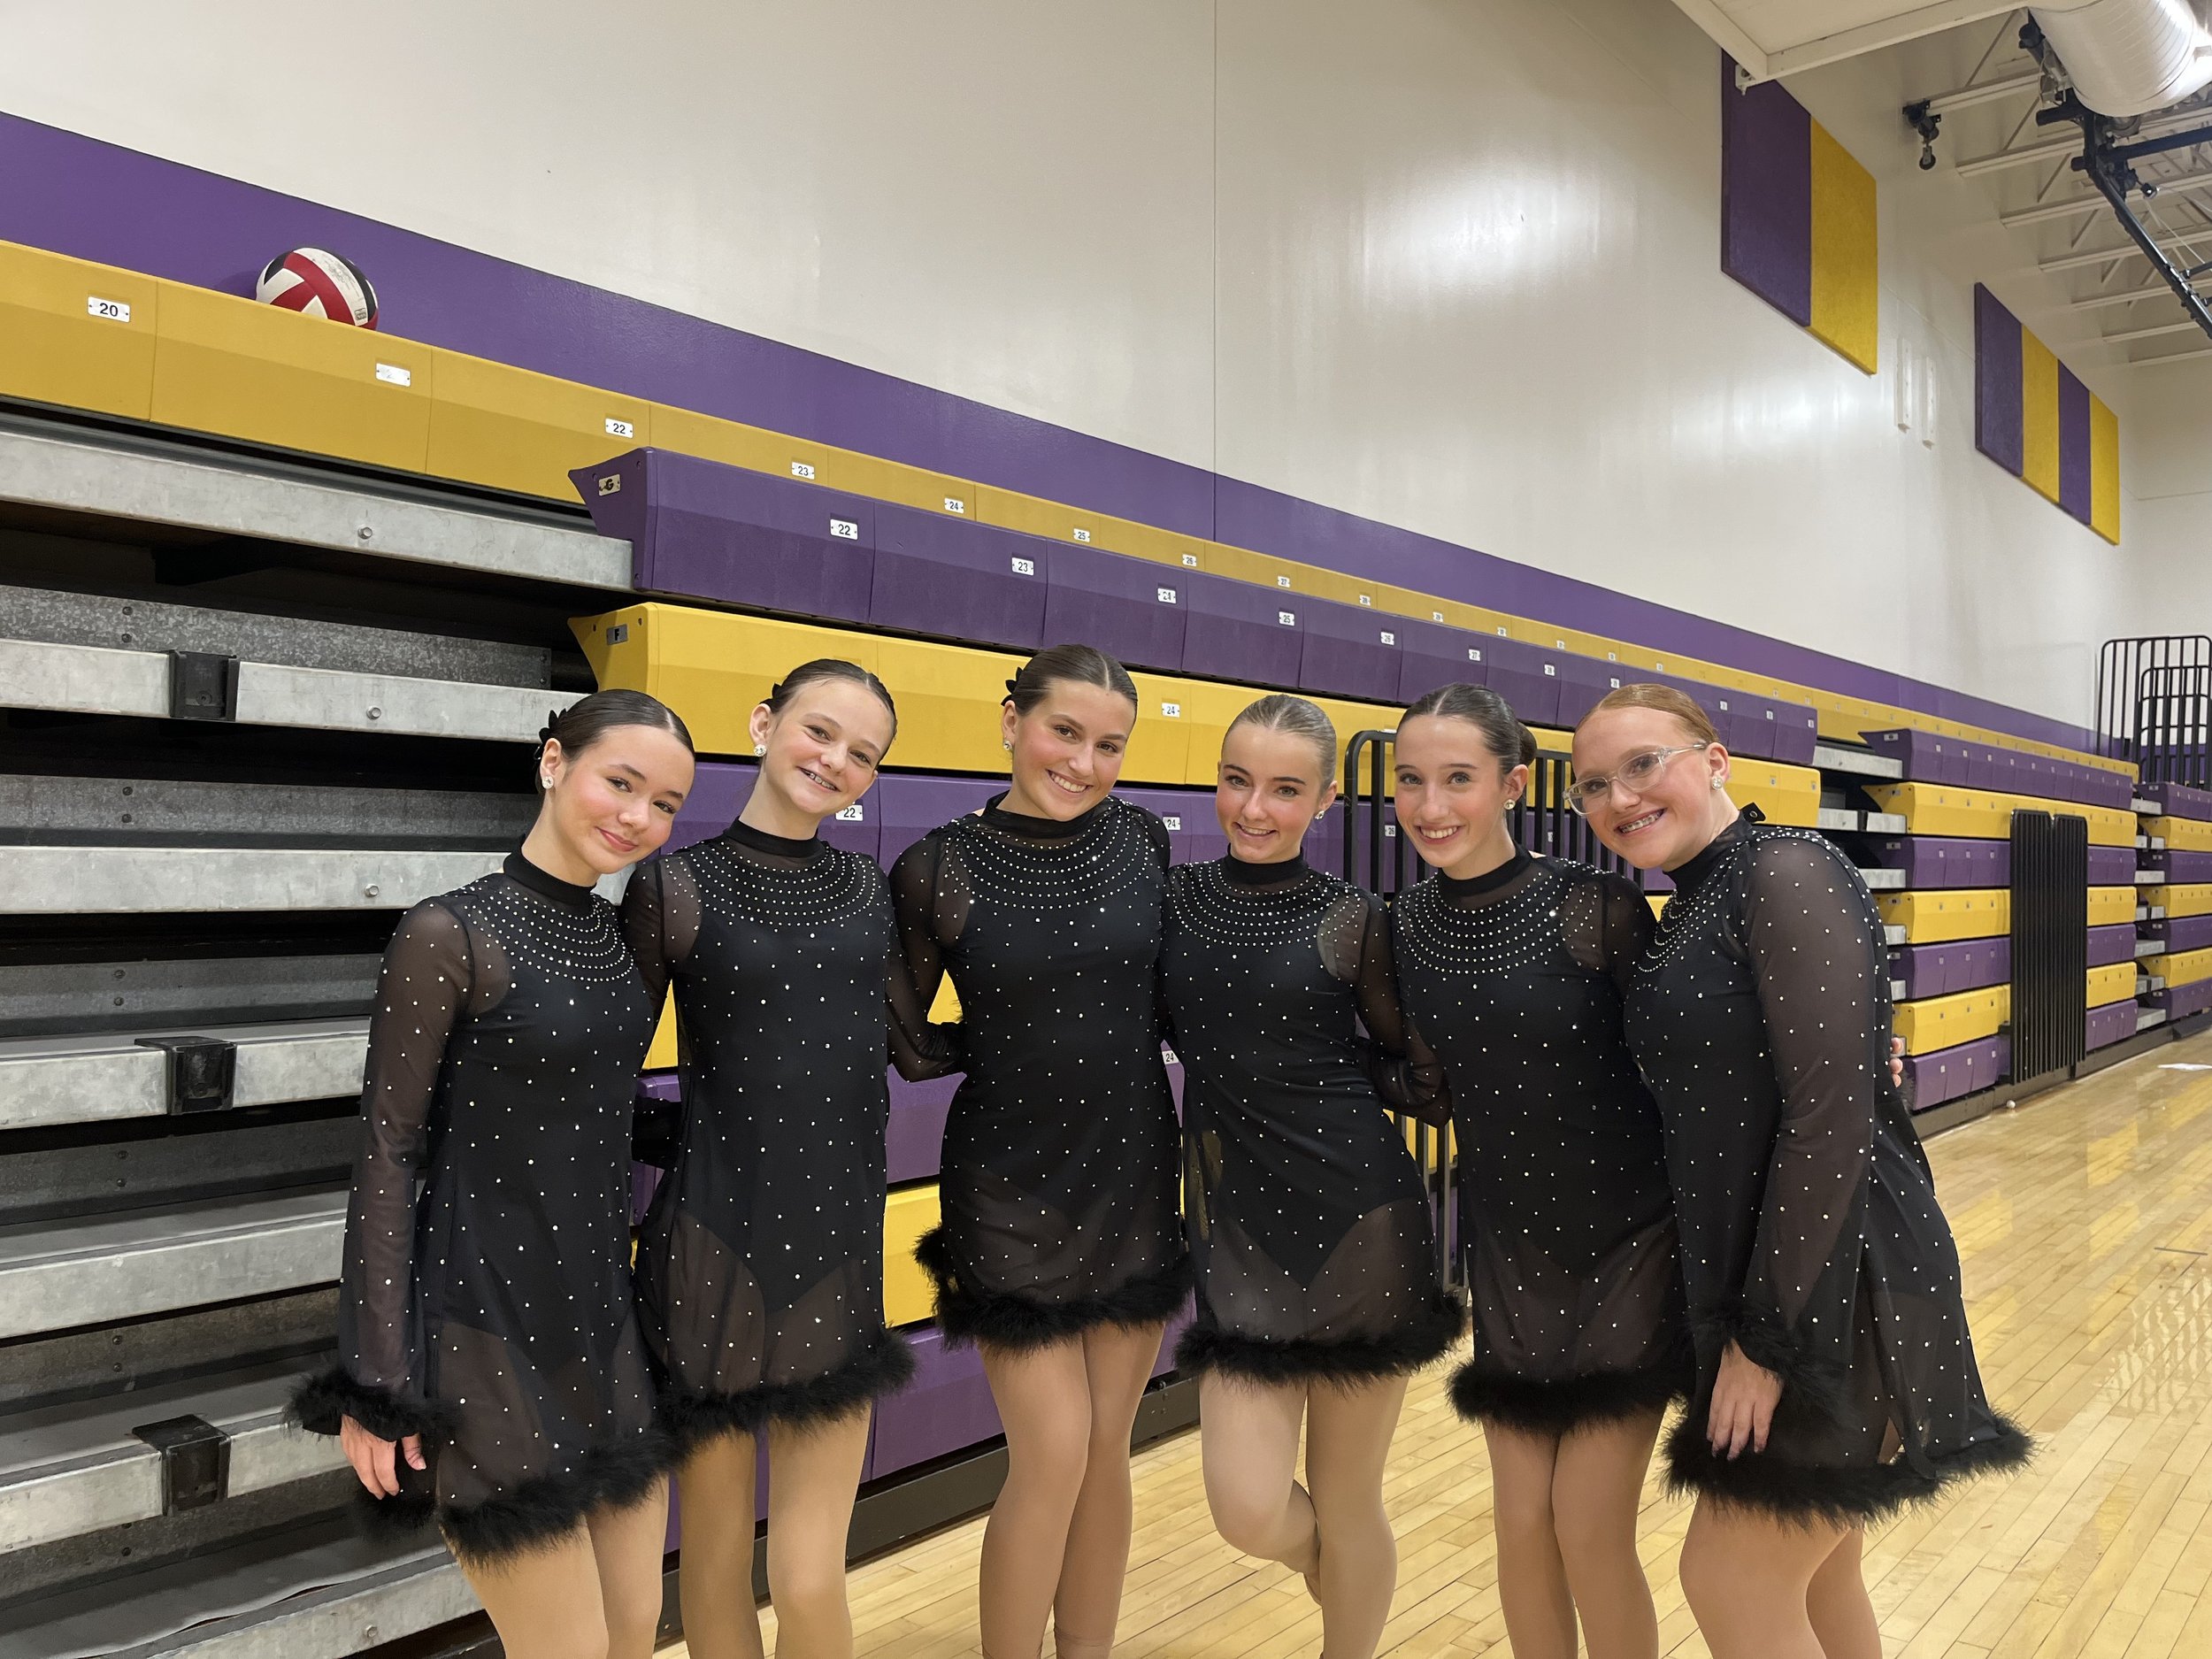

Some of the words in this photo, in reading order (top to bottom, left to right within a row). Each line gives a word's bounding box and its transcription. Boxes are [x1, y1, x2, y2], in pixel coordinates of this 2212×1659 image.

[99, 302, 119, 318] 20
[612, 422, 626, 435] 22
[797, 465, 809, 477] 23
[605, 478, 614, 491] G
[949, 501, 959, 511] 24
[838, 523, 851, 536] 22
[1077, 531, 1087, 541] 25
[1018, 561, 1029, 573] 23
[1163, 590, 1171, 601] 24
[1283, 614, 1291, 624] 25
[614, 628, 620, 641] F
[1166, 705, 1176, 716] 24
[842, 806, 856, 818] 22
[1167, 818, 1176, 828] 24
[1165, 1052, 1174, 1063] 24
